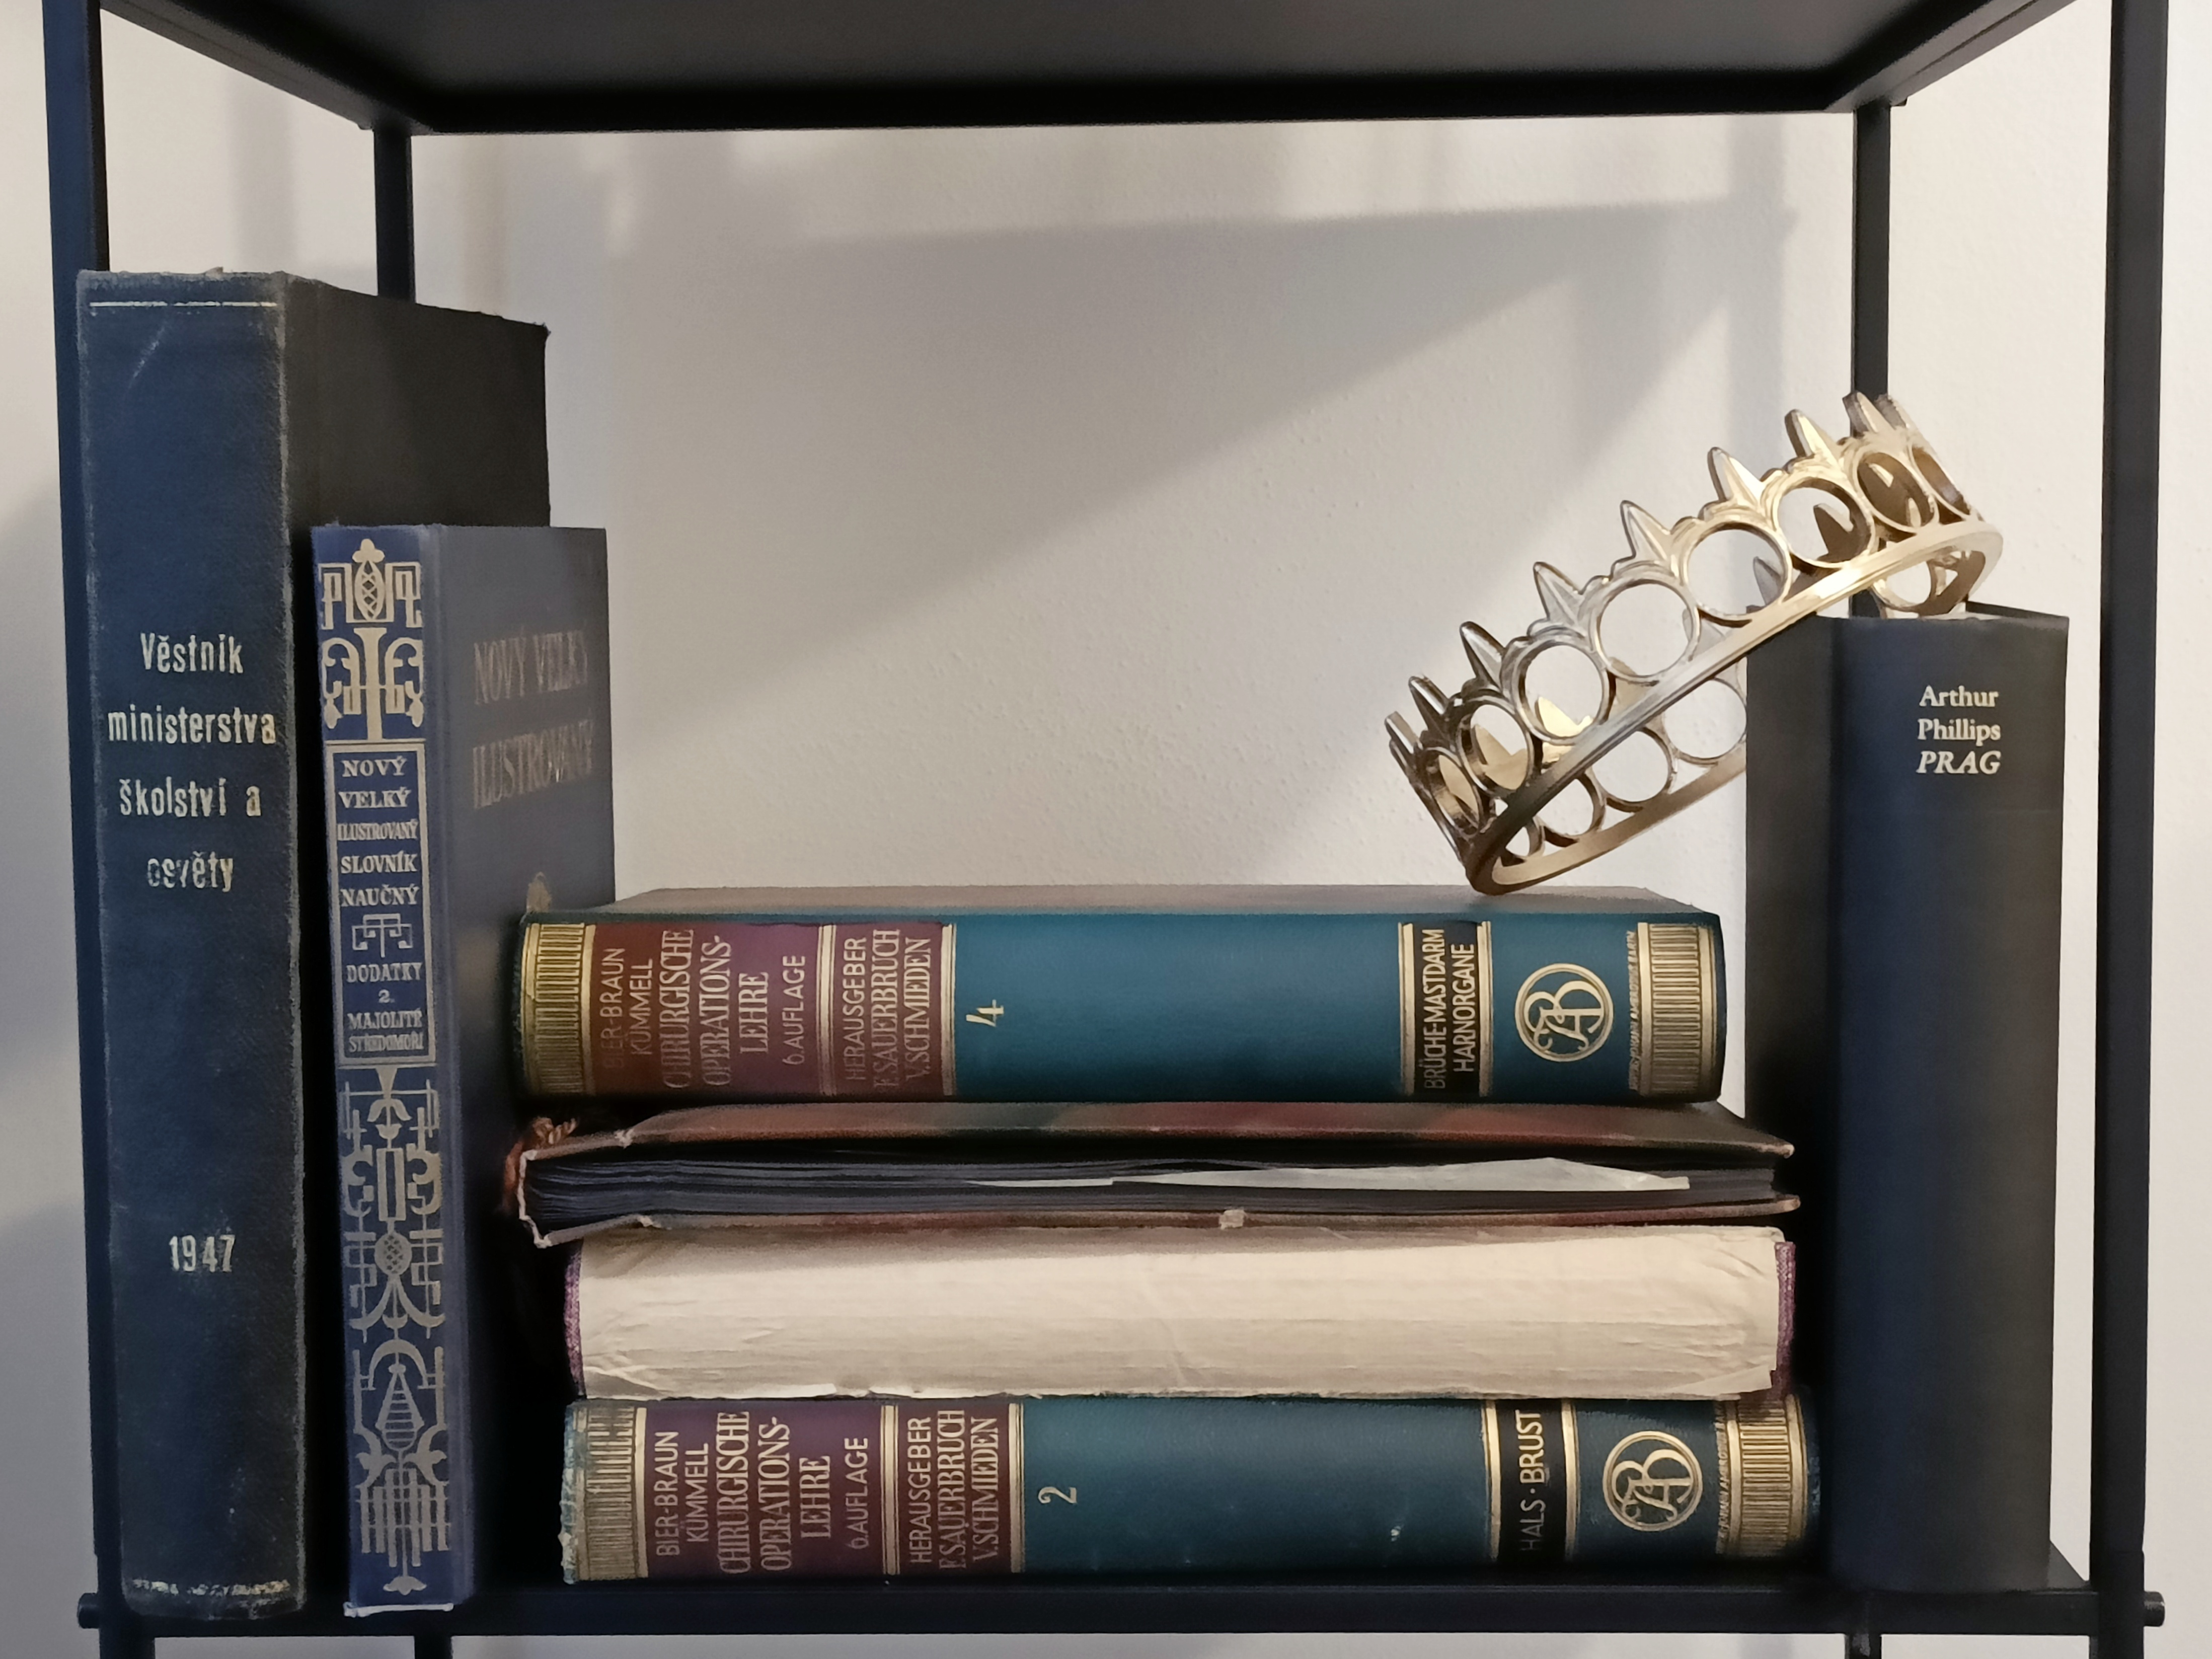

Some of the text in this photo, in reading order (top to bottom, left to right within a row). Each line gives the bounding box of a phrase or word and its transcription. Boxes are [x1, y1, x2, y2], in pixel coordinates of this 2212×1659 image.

[1919, 685, 1999, 707] Arthur
[108, 704, 276, 744] ministerstva
[1918, 718, 2001, 746] Phillips
[341, 756, 407, 777] NOVÝ
[1916, 750, 2001, 774] PRAG
[246, 786, 261, 816] a
[338, 787, 412, 808] VELKÝ
[341, 851, 417, 874] SLOVNÍK
[340, 883, 420, 907] NAUČNÝ
[346, 962, 423, 982] DODATKY
[659, 930, 694, 1088] CHIRURGISCHE
[699, 936, 731, 1085] OPERATIONS-
[738, 972, 768, 1053] LEHRE
[843, 937, 867, 1080] HERAUSGEBER
[966, 999, 1004, 1027] 4
[1451, 944, 1476, 1072] HARNORGANE
[169, 1234, 235, 1272] 1947
[1515, 1410, 1546, 1484] BRUST
[654, 1431, 679, 1556] BIER-BRAUN
[716, 1411, 750, 1573] CHIRURGISCHE
[757, 1417, 792, 1570] OPERATIONS-
[799, 1455, 831, 1539] LEHRE
[907, 1416, 932, 1563] HERAUSGEBER
[1037, 1486, 1077, 1504] 2
